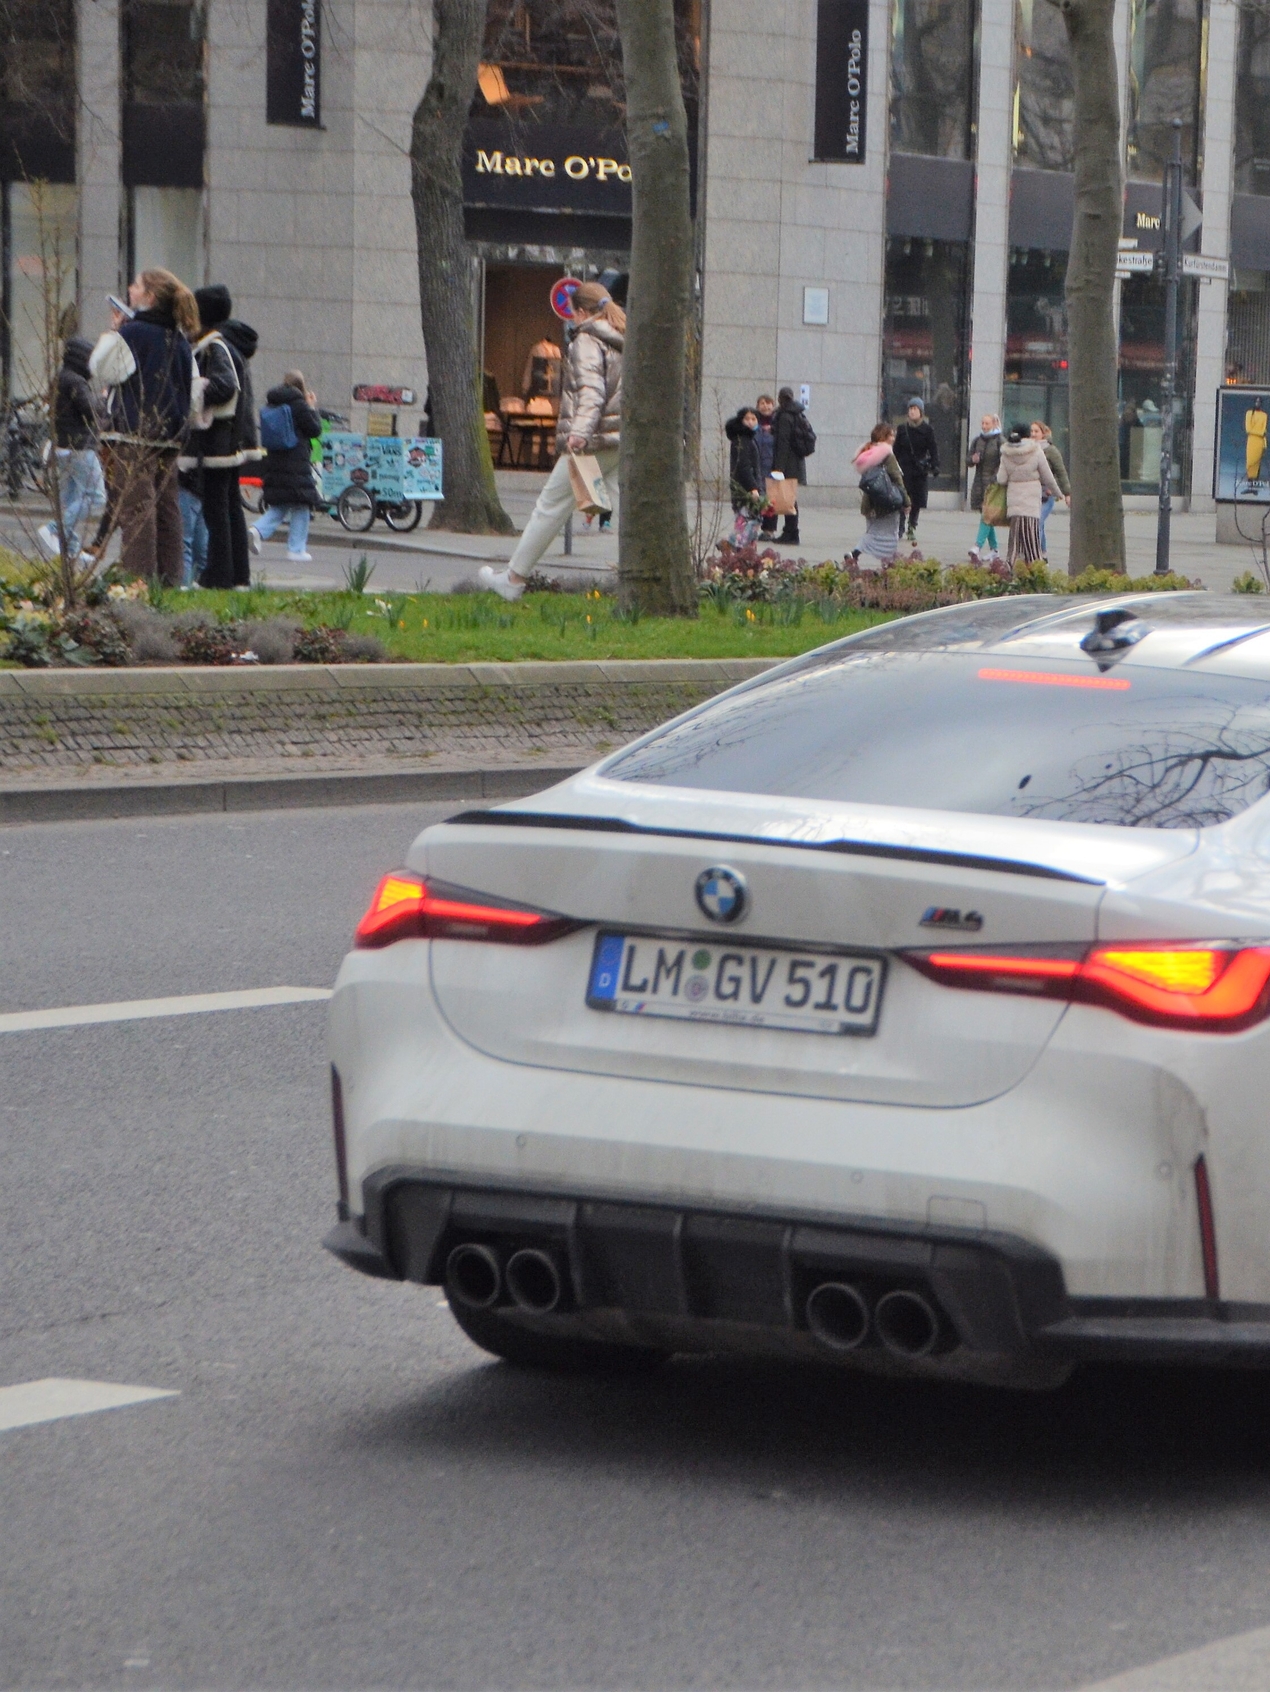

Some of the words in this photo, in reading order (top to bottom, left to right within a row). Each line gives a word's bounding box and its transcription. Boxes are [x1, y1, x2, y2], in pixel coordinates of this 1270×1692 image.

[301, 60, 315, 118] Marc
[847, 28, 862, 98] O'Polo
[846, 100, 860, 154] Marc
[475, 150, 555, 178] Marc
[564, 155, 633, 182] O'Po
[1119, 254, 1152, 267] kestraße
[599, 972, 610, 988] D
[621, 944, 687, 997] LM
[714, 953, 777, 1004] GV
[784, 959, 874, 1014] 510
